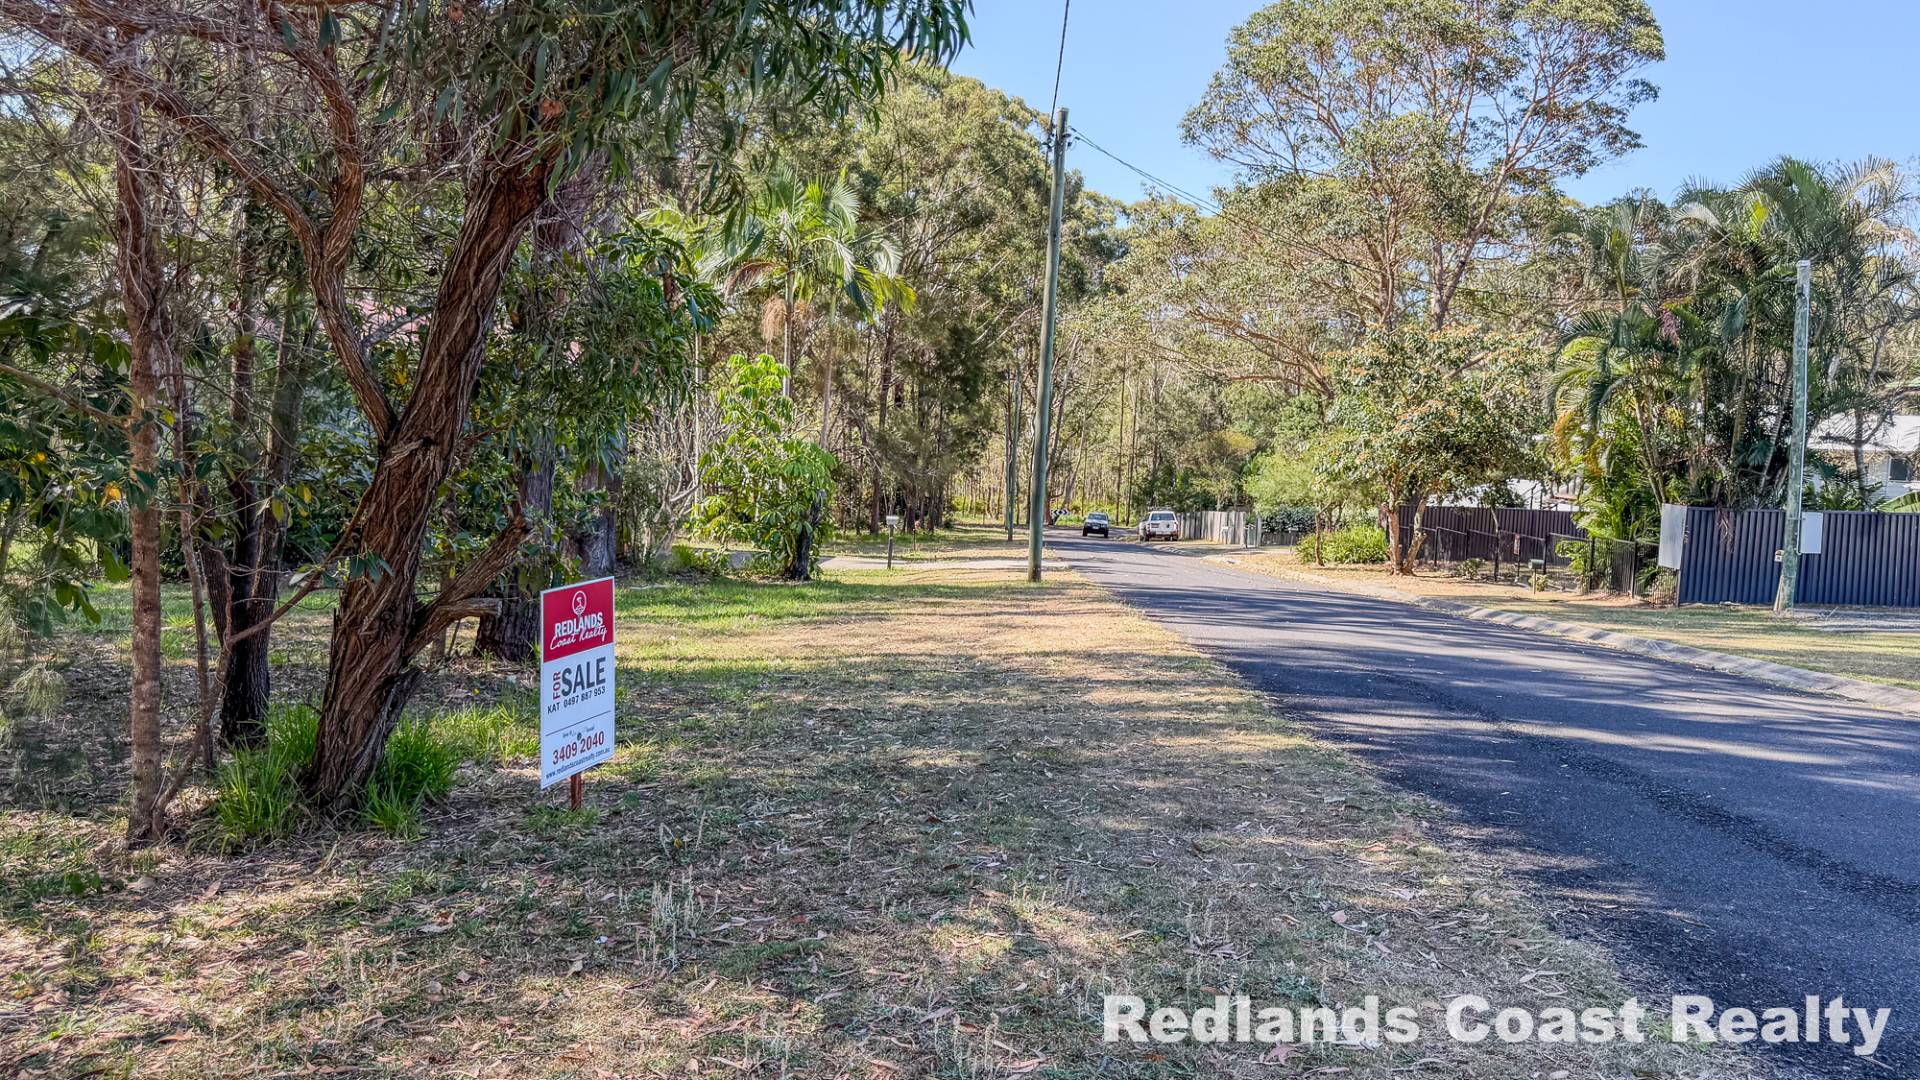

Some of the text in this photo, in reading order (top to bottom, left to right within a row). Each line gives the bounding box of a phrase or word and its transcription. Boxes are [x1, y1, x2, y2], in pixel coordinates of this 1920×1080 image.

[550, 624, 607, 650] Coast Realty
[555, 612, 604, 637] REDLANDS
[553, 656, 606, 700] FOR SALE
[547, 685, 606, 715] KAT 0497 887 953
[552, 741, 577, 765] 3409
[580, 730, 605, 754] 2040
